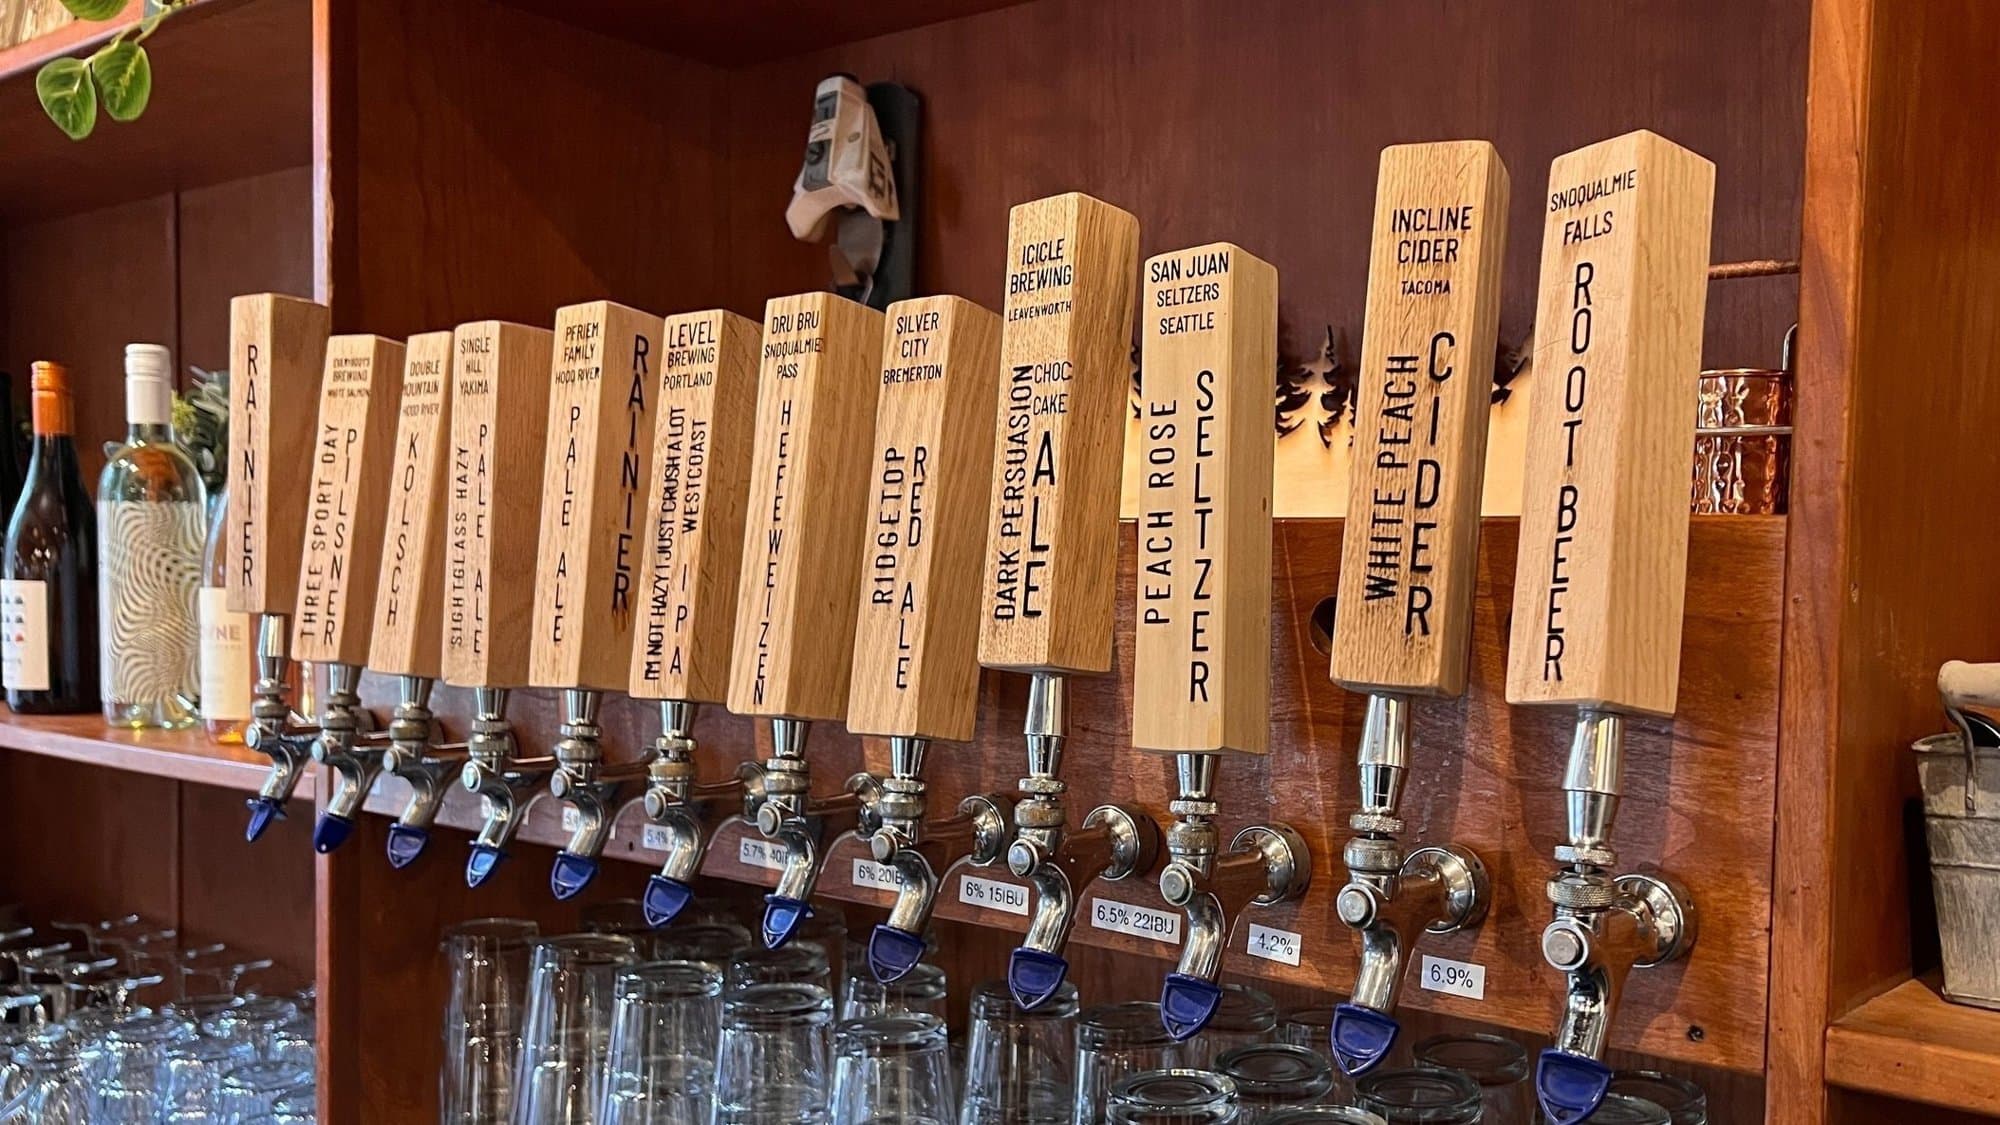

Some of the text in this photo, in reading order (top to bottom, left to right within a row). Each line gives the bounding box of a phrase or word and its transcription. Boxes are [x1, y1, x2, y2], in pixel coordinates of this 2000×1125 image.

[1550, 169, 1637, 213] SNOQUALMIE
[1392, 206, 1473, 233] INCLINE
[1563, 211, 1613, 246] FALLS
[1022, 238, 1065, 266] ICICLE
[1397, 238, 1458, 264] CIDER
[1010, 264, 1072, 295] BREWING
[1151, 252, 1229, 283] SAN JUAN
[1157, 283, 1220, 308] SELTZERS
[1401, 280, 1451, 296] TACOMA
[772, 311, 820, 335] DRU BRU
[896, 312, 939, 335] SILVER
[1008, 301, 1072, 322] LEAVENWORTH
[1160, 312, 1215, 335] SEATTLE
[565, 322, 599, 340] PFRIEM
[669, 321, 716, 349] LEVEL
[460, 337, 491, 354] SINGLE
[564, 343, 595, 363] FAMILY
[667, 347, 715, 369] BREWING
[764, 338, 824, 359] SNOQUALMIE
[901, 338, 930, 358] CITY
[410, 360, 440, 377] DOUBLE
[466, 359, 482, 374] HILL
[555, 367, 600, 386] HOOD RIVER
[663, 371, 713, 390] PORTLAND
[777, 363, 799, 380] PASS
[883, 364, 943, 384] BREMERTON
[1034, 360, 1073, 384] CHOC
[460, 380, 489, 397] YAKIMA
[1033, 393, 1069, 416] CAKE
[242, 345, 258, 587] RAINIER
[612, 334, 649, 610] RAINIER
[682, 419, 707, 534] WESTCOAST
[1365, 355, 1419, 601] WHITE PEACH
[1544, 261, 1594, 682] ROOT BEER
[661, 456, 681, 513] CRUSH
[994, 365, 1034, 621] DARK PERSUASION
[1405, 332, 1456, 636] CIDER
[552, 406, 581, 642] PALE ALE
[872, 447, 905, 605] RIDGETOP
[1023, 430, 1055, 617] ALE
[1144, 399, 1177, 625] PEACH ROSE
[301, 424, 339, 639] THREE SPORT DAY
[323, 429, 357, 646] PILSNER
[386, 432, 419, 627] KOLSCH
[473, 424, 488, 653] PALE ALE
[657, 518, 675, 561] JUST
[1190, 370, 1215, 703] SELTZER
[451, 447, 469, 648] SIGHTGLASS HAZY
[753, 399, 792, 705] HEFEWEIZEN
[896, 446, 927, 688] RED ALE
[650, 574, 670, 616] HAZY
[670, 563, 688, 674] IPA
[647, 621, 665, 656] NOT
[743, 842, 767, 860] 5.7%
[859, 865, 905, 885] 6% 20IB
[966, 886, 1025, 908] 6% 15IBU
[1097, 904, 1175, 936] 6.5% 22IBU
[1256, 932, 1294, 956] 4.2%
[1430, 963, 1474, 989] 6.9%
